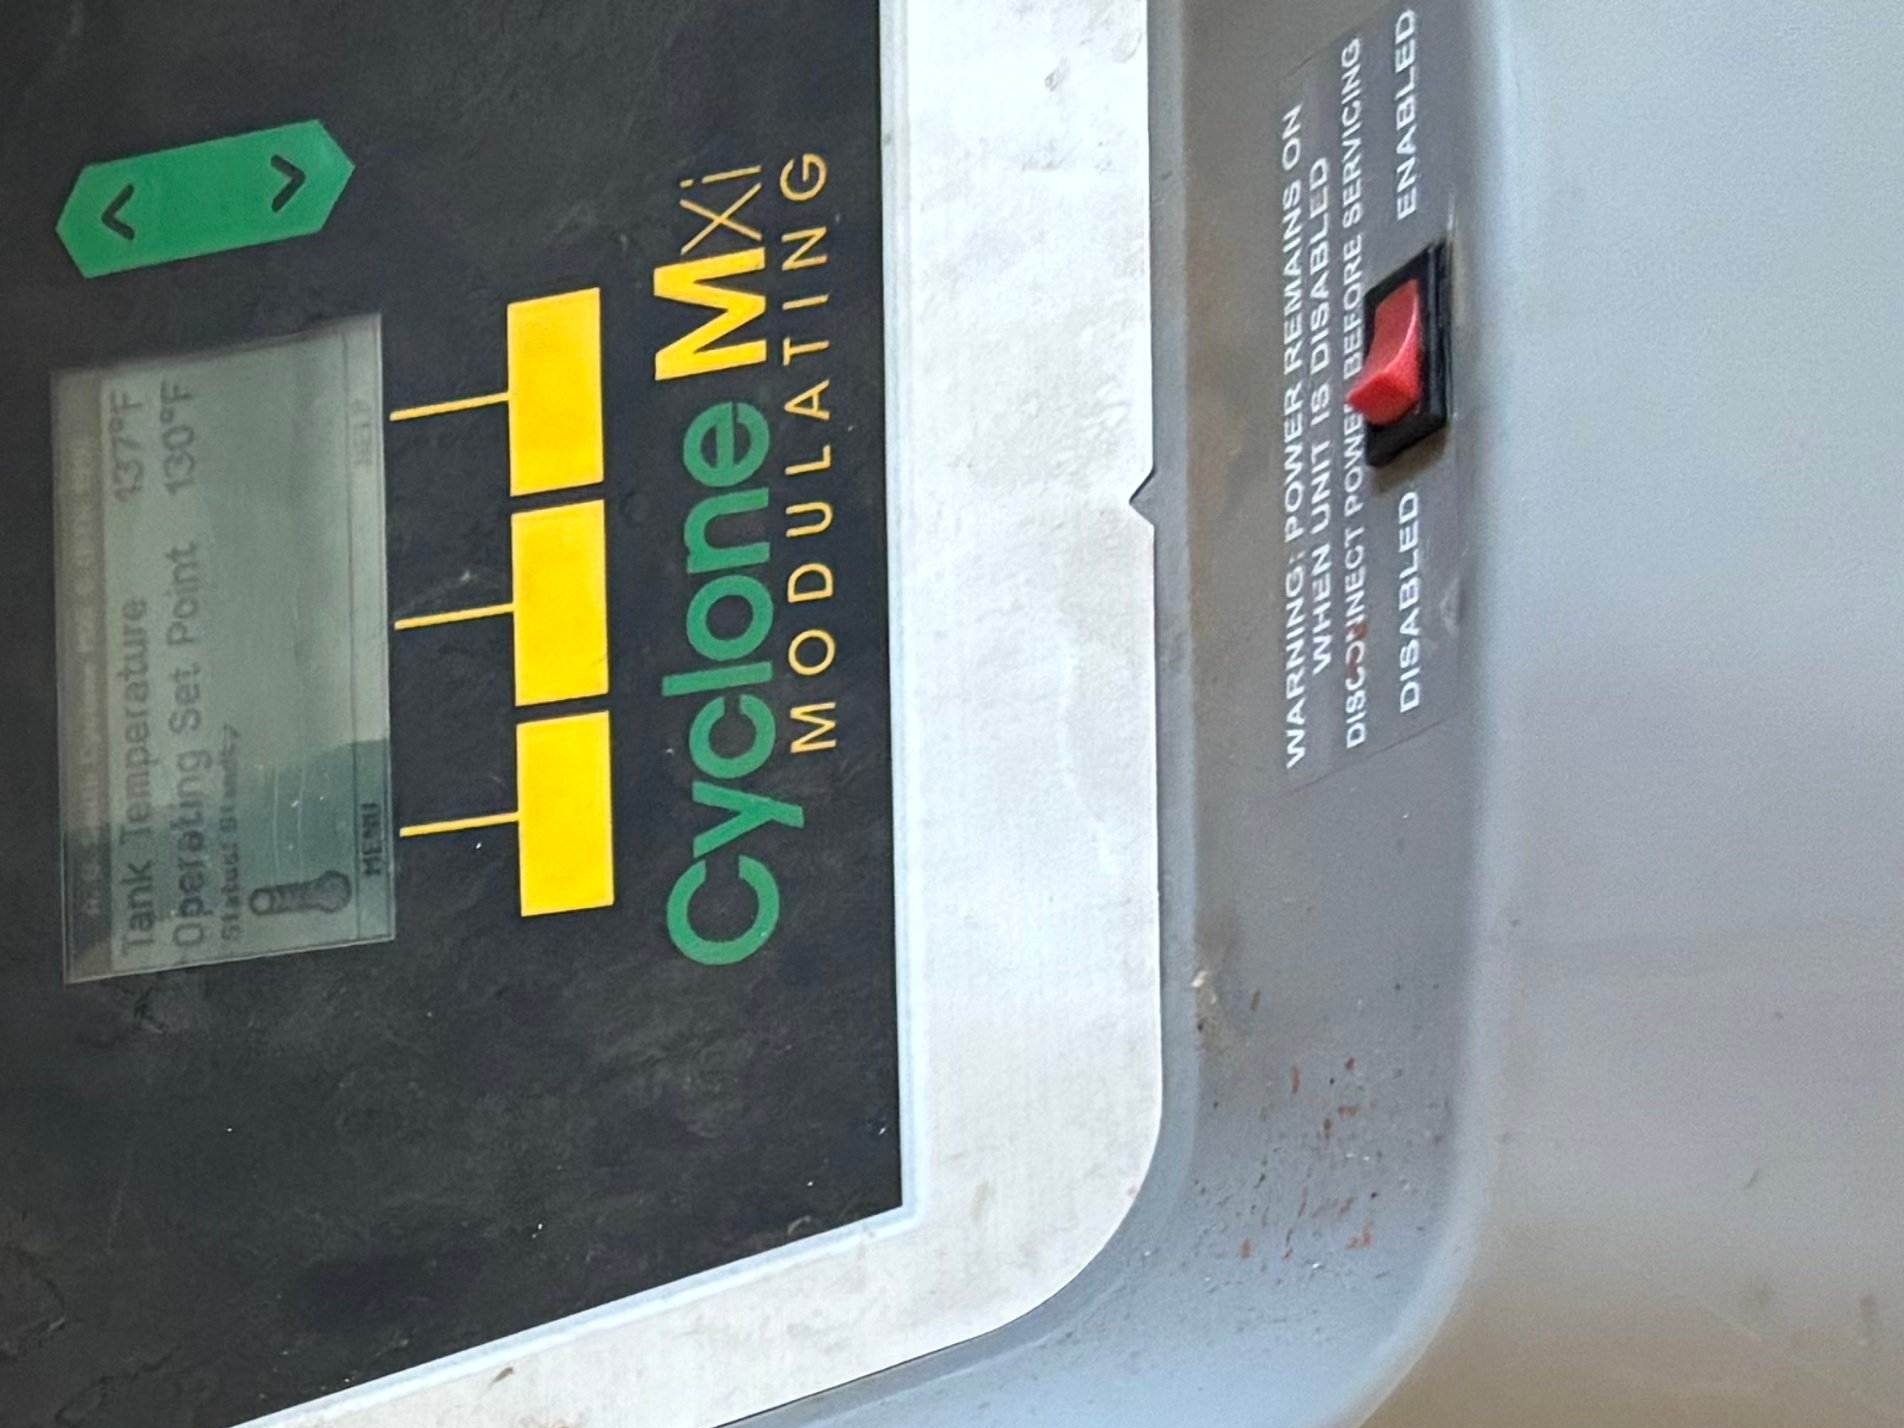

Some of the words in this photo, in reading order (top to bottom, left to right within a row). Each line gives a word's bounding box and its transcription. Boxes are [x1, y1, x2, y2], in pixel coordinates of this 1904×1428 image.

[1282, 103, 1302, 173] ON
[1341, 37, 1362, 229] SERVICING
[1395, 8, 1417, 221] ENABLED
[653, 164, 767, 381] MXi
[1282, 180, 1302, 375] REMAINS
[1309, 157, 1329, 375] DISABLED
[1343, 233, 1363, 380] BEFORE
[780, 152, 837, 755] MODULATING
[1283, 381, 1304, 543] POWER
[1310, 381, 1330, 426] IS
[1310, 440, 1331, 535] UNIT
[162, 542, 201, 646] Point
[662, 401, 804, 966] Cyclone
[1284, 551, 1306, 768] WARNING:
[1311, 543, 1332, 676] WHEN
[1399, 490, 1420, 713] DISABLED
[115, 597, 160, 842] Temperature
[166, 665, 202, 733] Set
[118, 861, 155, 957] Tank
[167, 748, 215, 949] Operating
